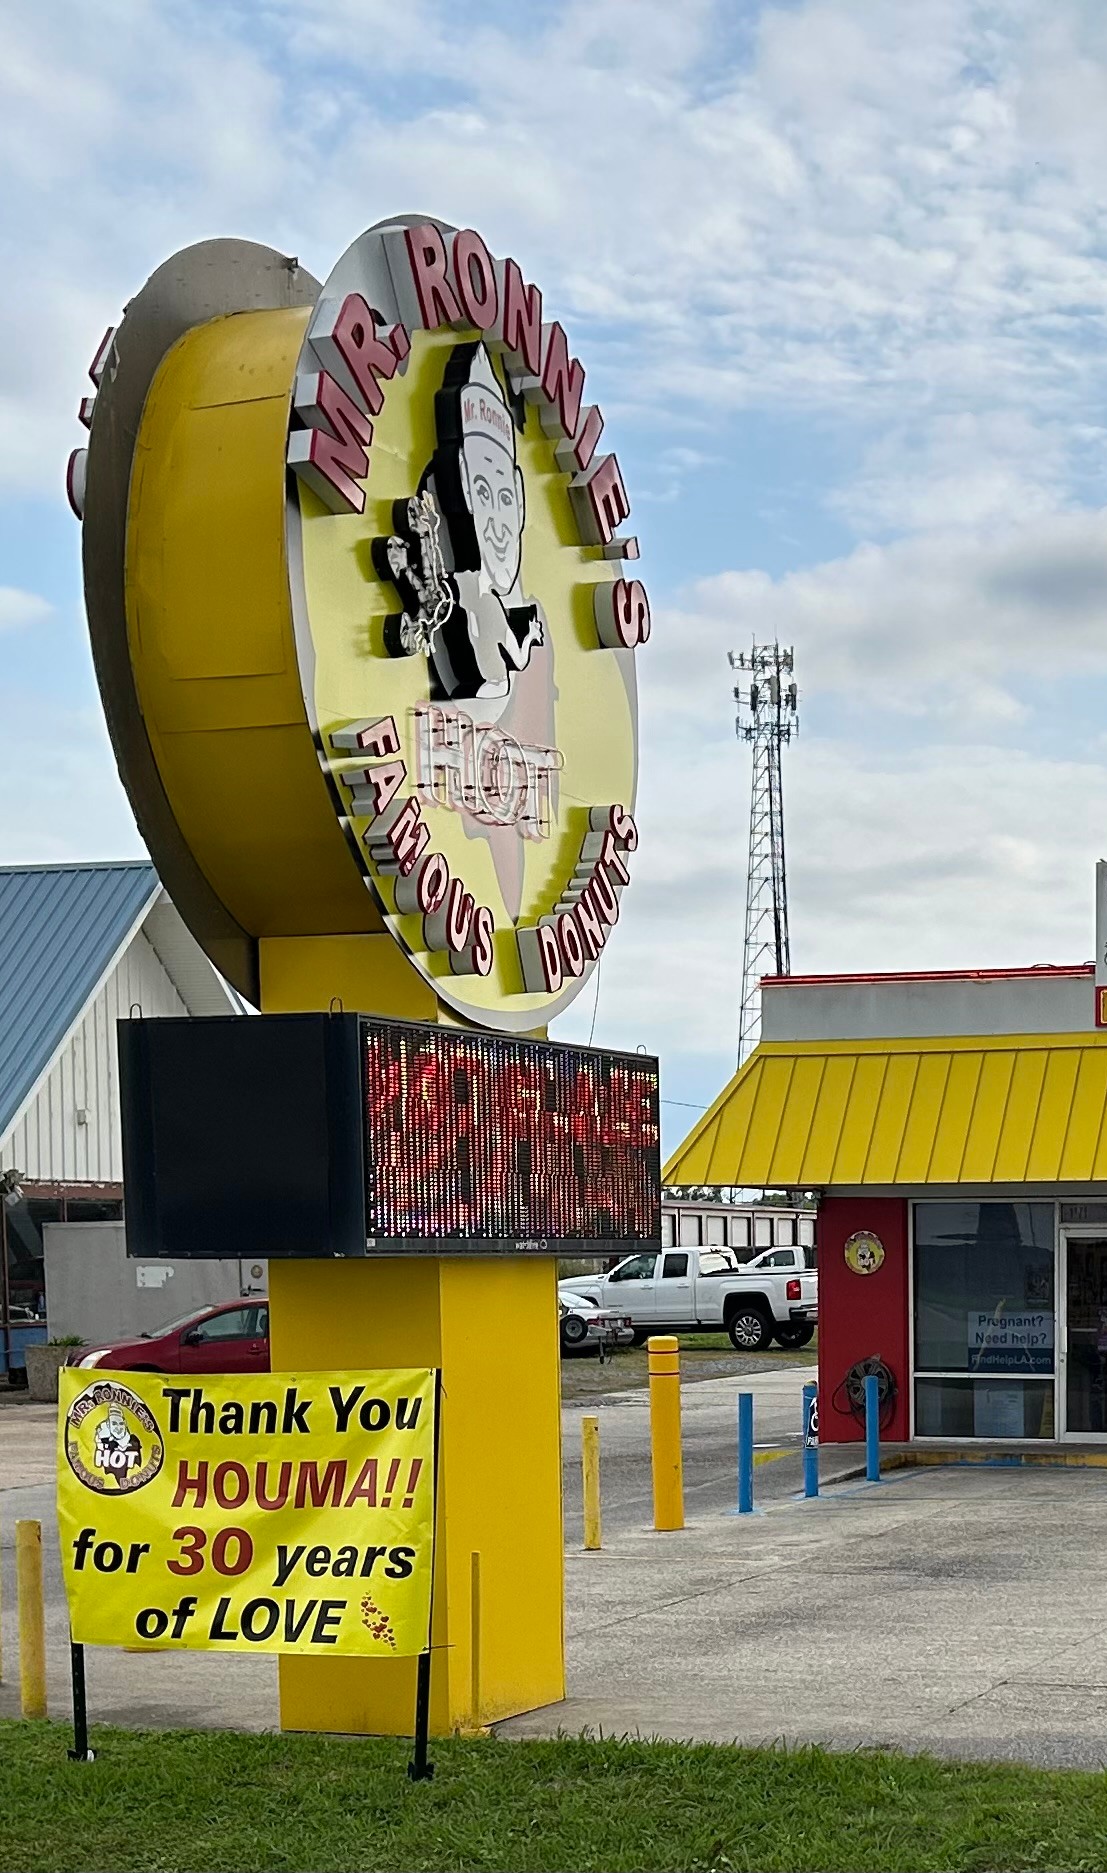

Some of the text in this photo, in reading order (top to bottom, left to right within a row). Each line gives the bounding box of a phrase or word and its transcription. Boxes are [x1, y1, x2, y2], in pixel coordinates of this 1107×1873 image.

[310, 223, 651, 649] MR. RONNIE'S
[412, 702, 566, 843] HOT
[357, 716, 495, 977] FAMOUS
[537, 804, 639, 993] DONUTS
[975, 1332, 1047, 1346] Need help?
[978, 1315, 1044, 1330] Pregnant?
[162, 1385, 423, 1435] Thank You
[95, 1450, 139, 1469] HOT
[171, 1458, 423, 1512] HOUMA!!
[72, 1525, 416, 1587] for 30 years
[135, 1596, 348, 1644] of LOVE
